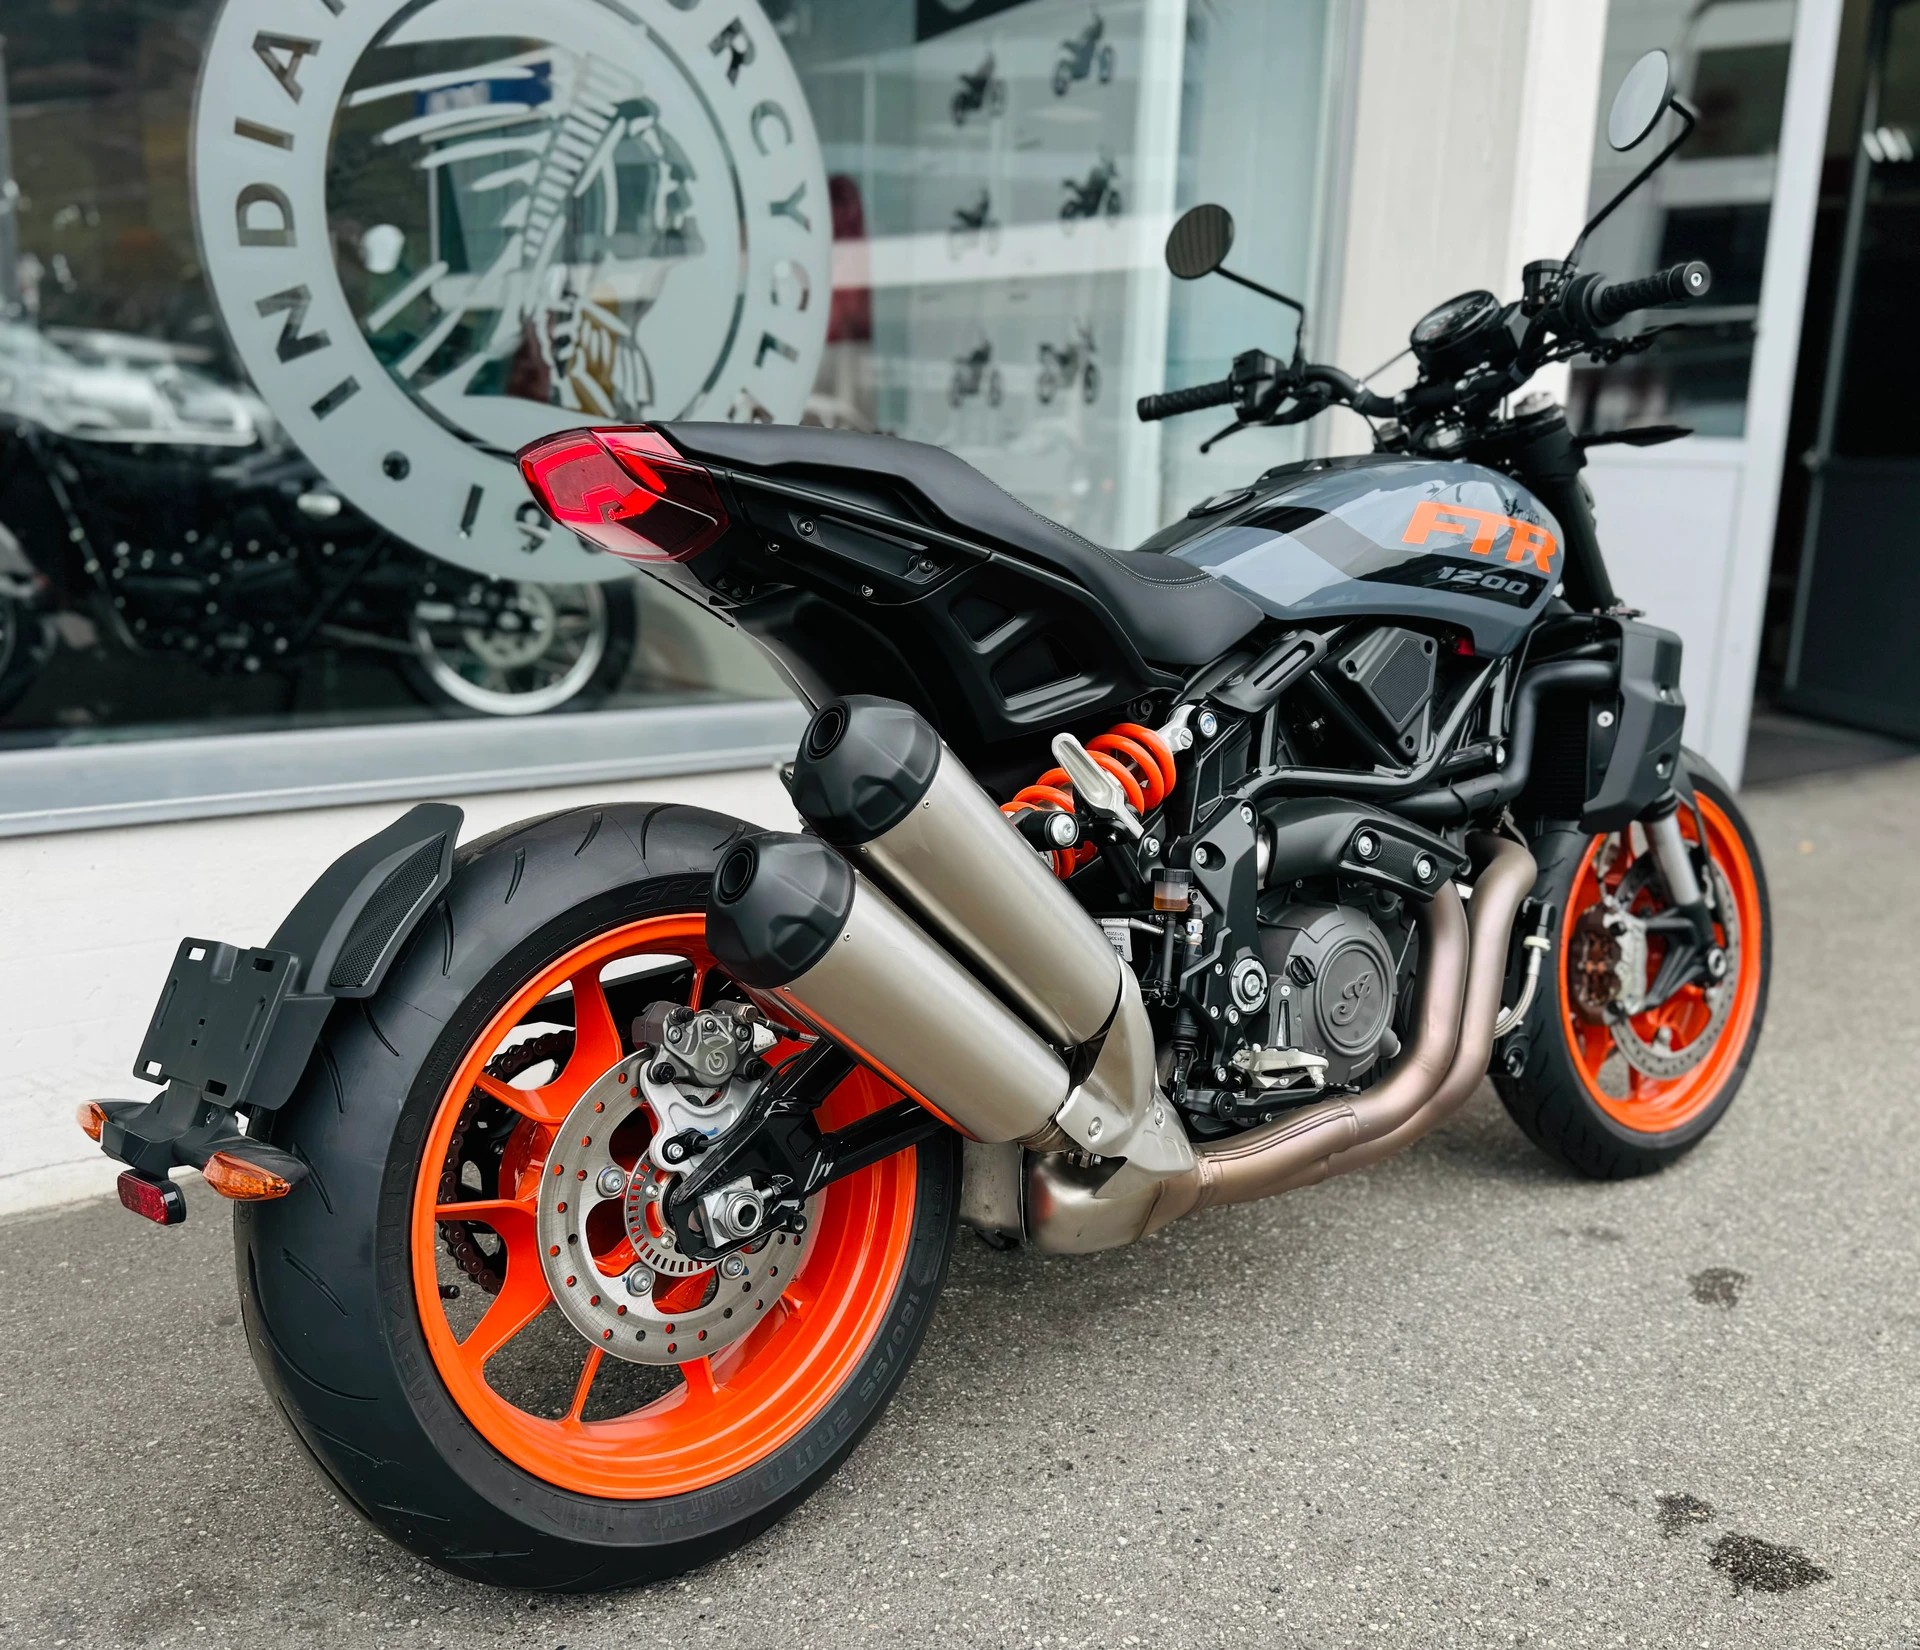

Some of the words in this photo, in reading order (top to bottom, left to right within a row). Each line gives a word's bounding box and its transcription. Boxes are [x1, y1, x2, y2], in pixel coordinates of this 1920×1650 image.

[234, 0, 360, 421] INDIA
[1401, 500, 1558, 574] FTR
[1438, 566, 1530, 596] 1200
[857, 1292, 921, 1402] 180/55
